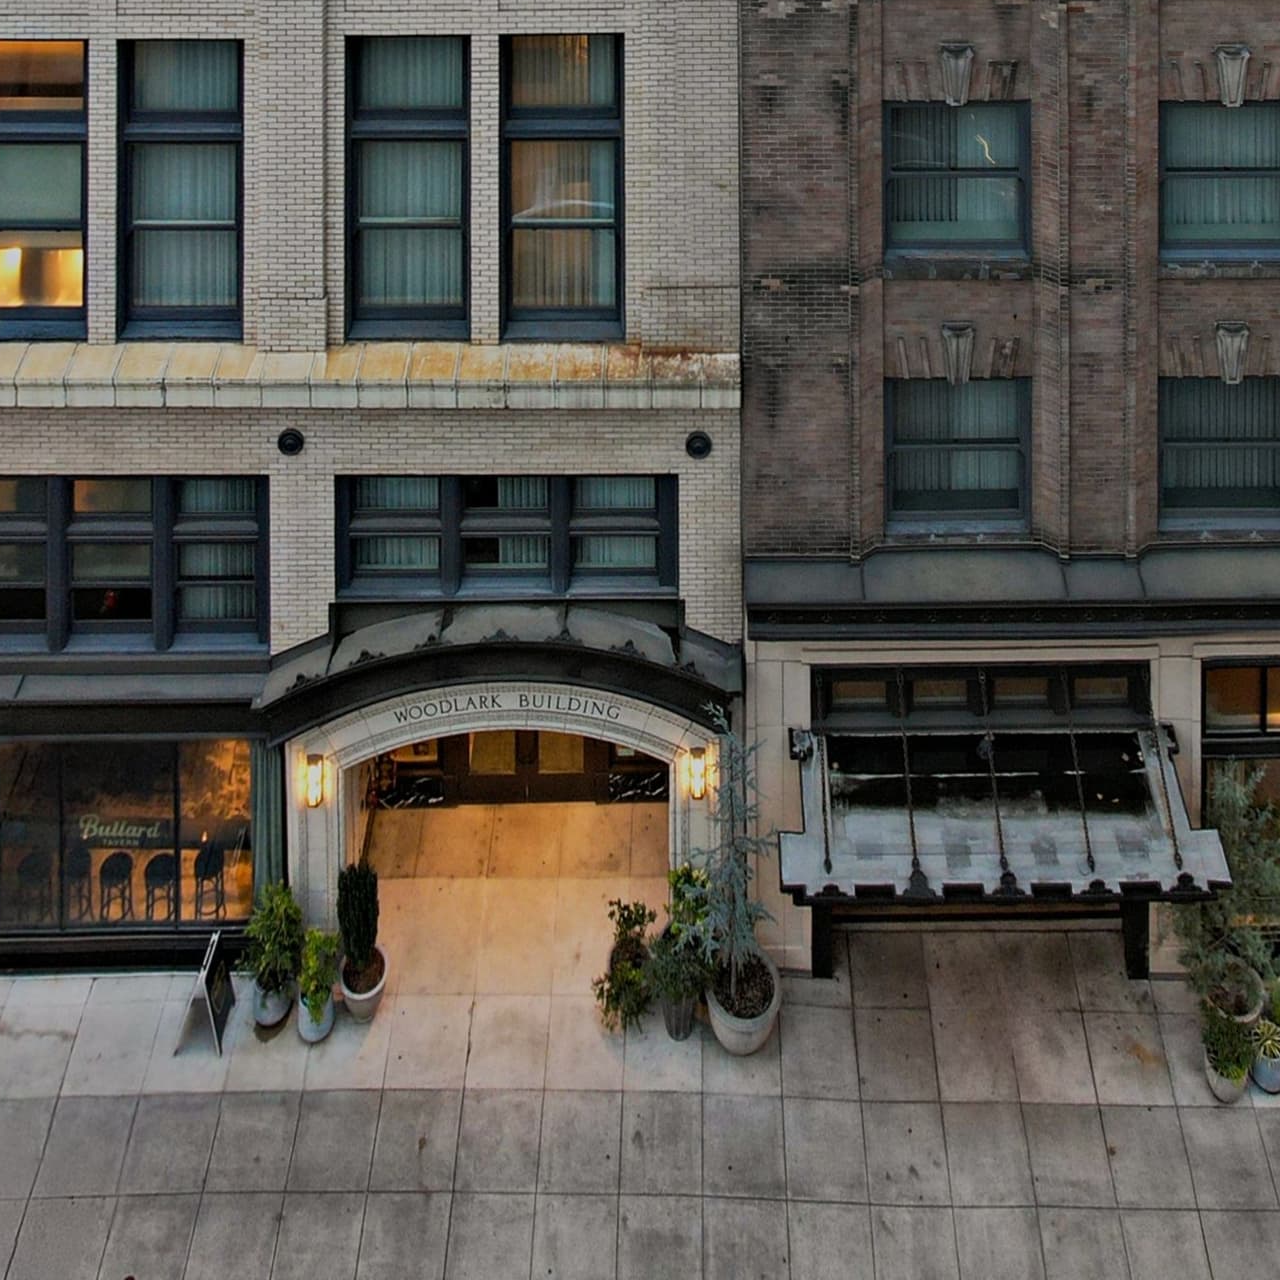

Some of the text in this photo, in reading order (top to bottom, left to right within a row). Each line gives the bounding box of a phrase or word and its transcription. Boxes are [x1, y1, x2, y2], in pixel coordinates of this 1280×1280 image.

[393, 694, 620, 724] WOODLARK BUILDING
[80, 814, 160, 839] Bullard
